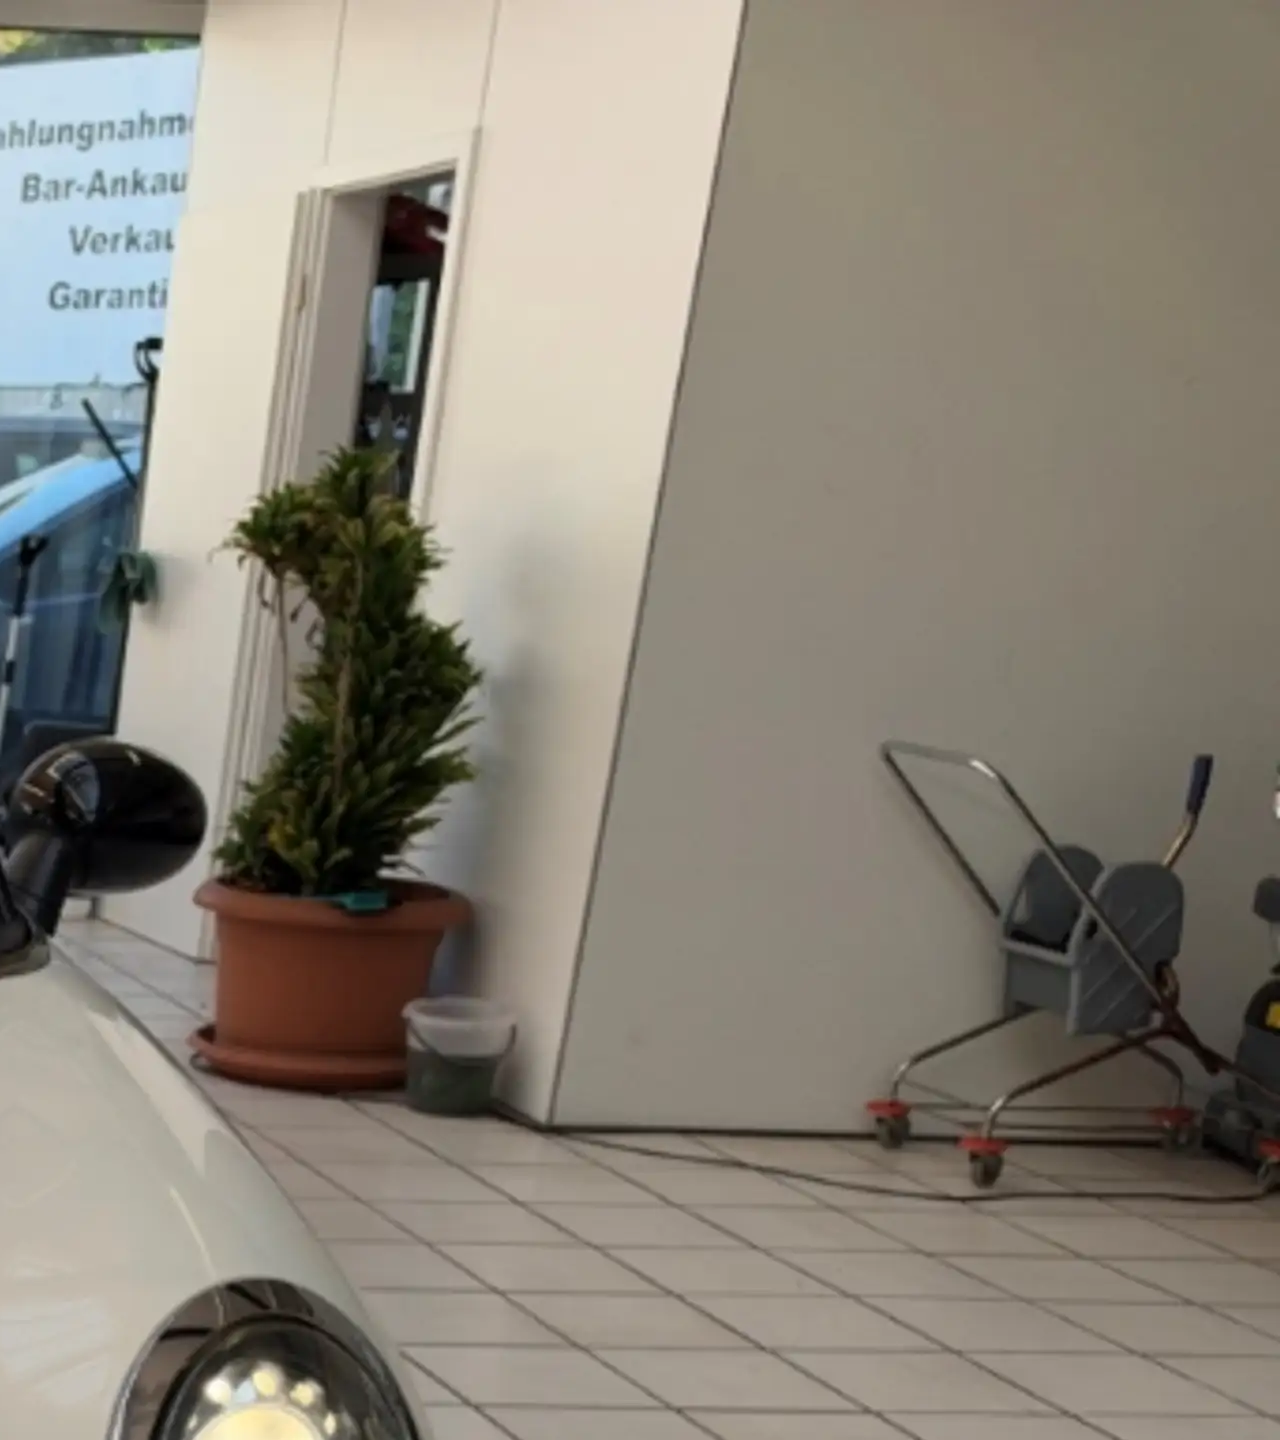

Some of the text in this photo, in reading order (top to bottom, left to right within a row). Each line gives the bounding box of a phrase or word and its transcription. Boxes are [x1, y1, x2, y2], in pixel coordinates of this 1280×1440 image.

[21, 168, 187, 203] Bar-Ankau
[68, 223, 175, 256] Verkau
[48, 277, 169, 310] Garanti
